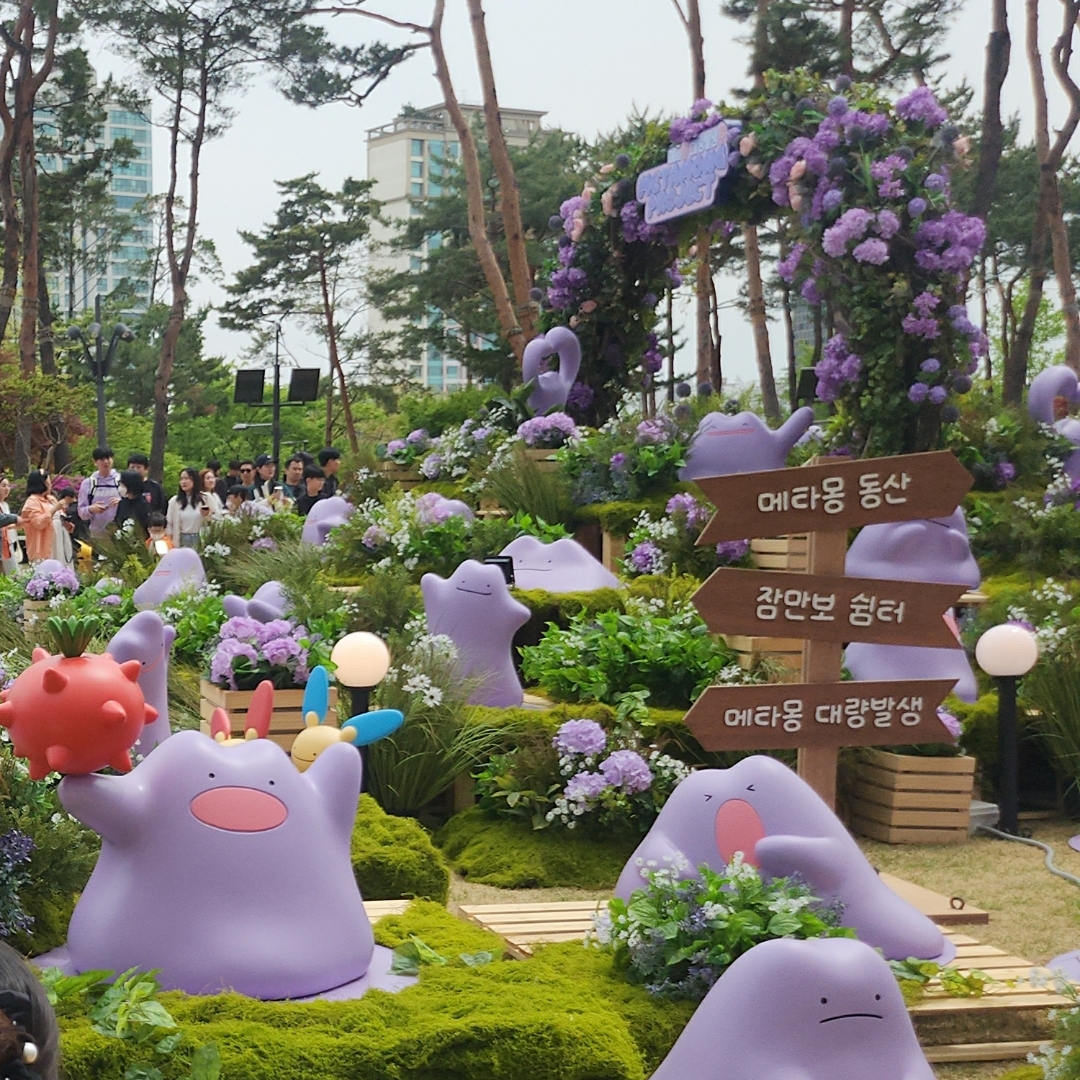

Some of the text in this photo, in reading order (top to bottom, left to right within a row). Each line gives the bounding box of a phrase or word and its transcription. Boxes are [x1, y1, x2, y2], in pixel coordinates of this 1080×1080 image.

[758, 472, 912, 514] 메타몽 동산
[756, 586, 906, 627] 잠만보 쉼터
[724, 697, 923, 733] 메타몽 대량발생
